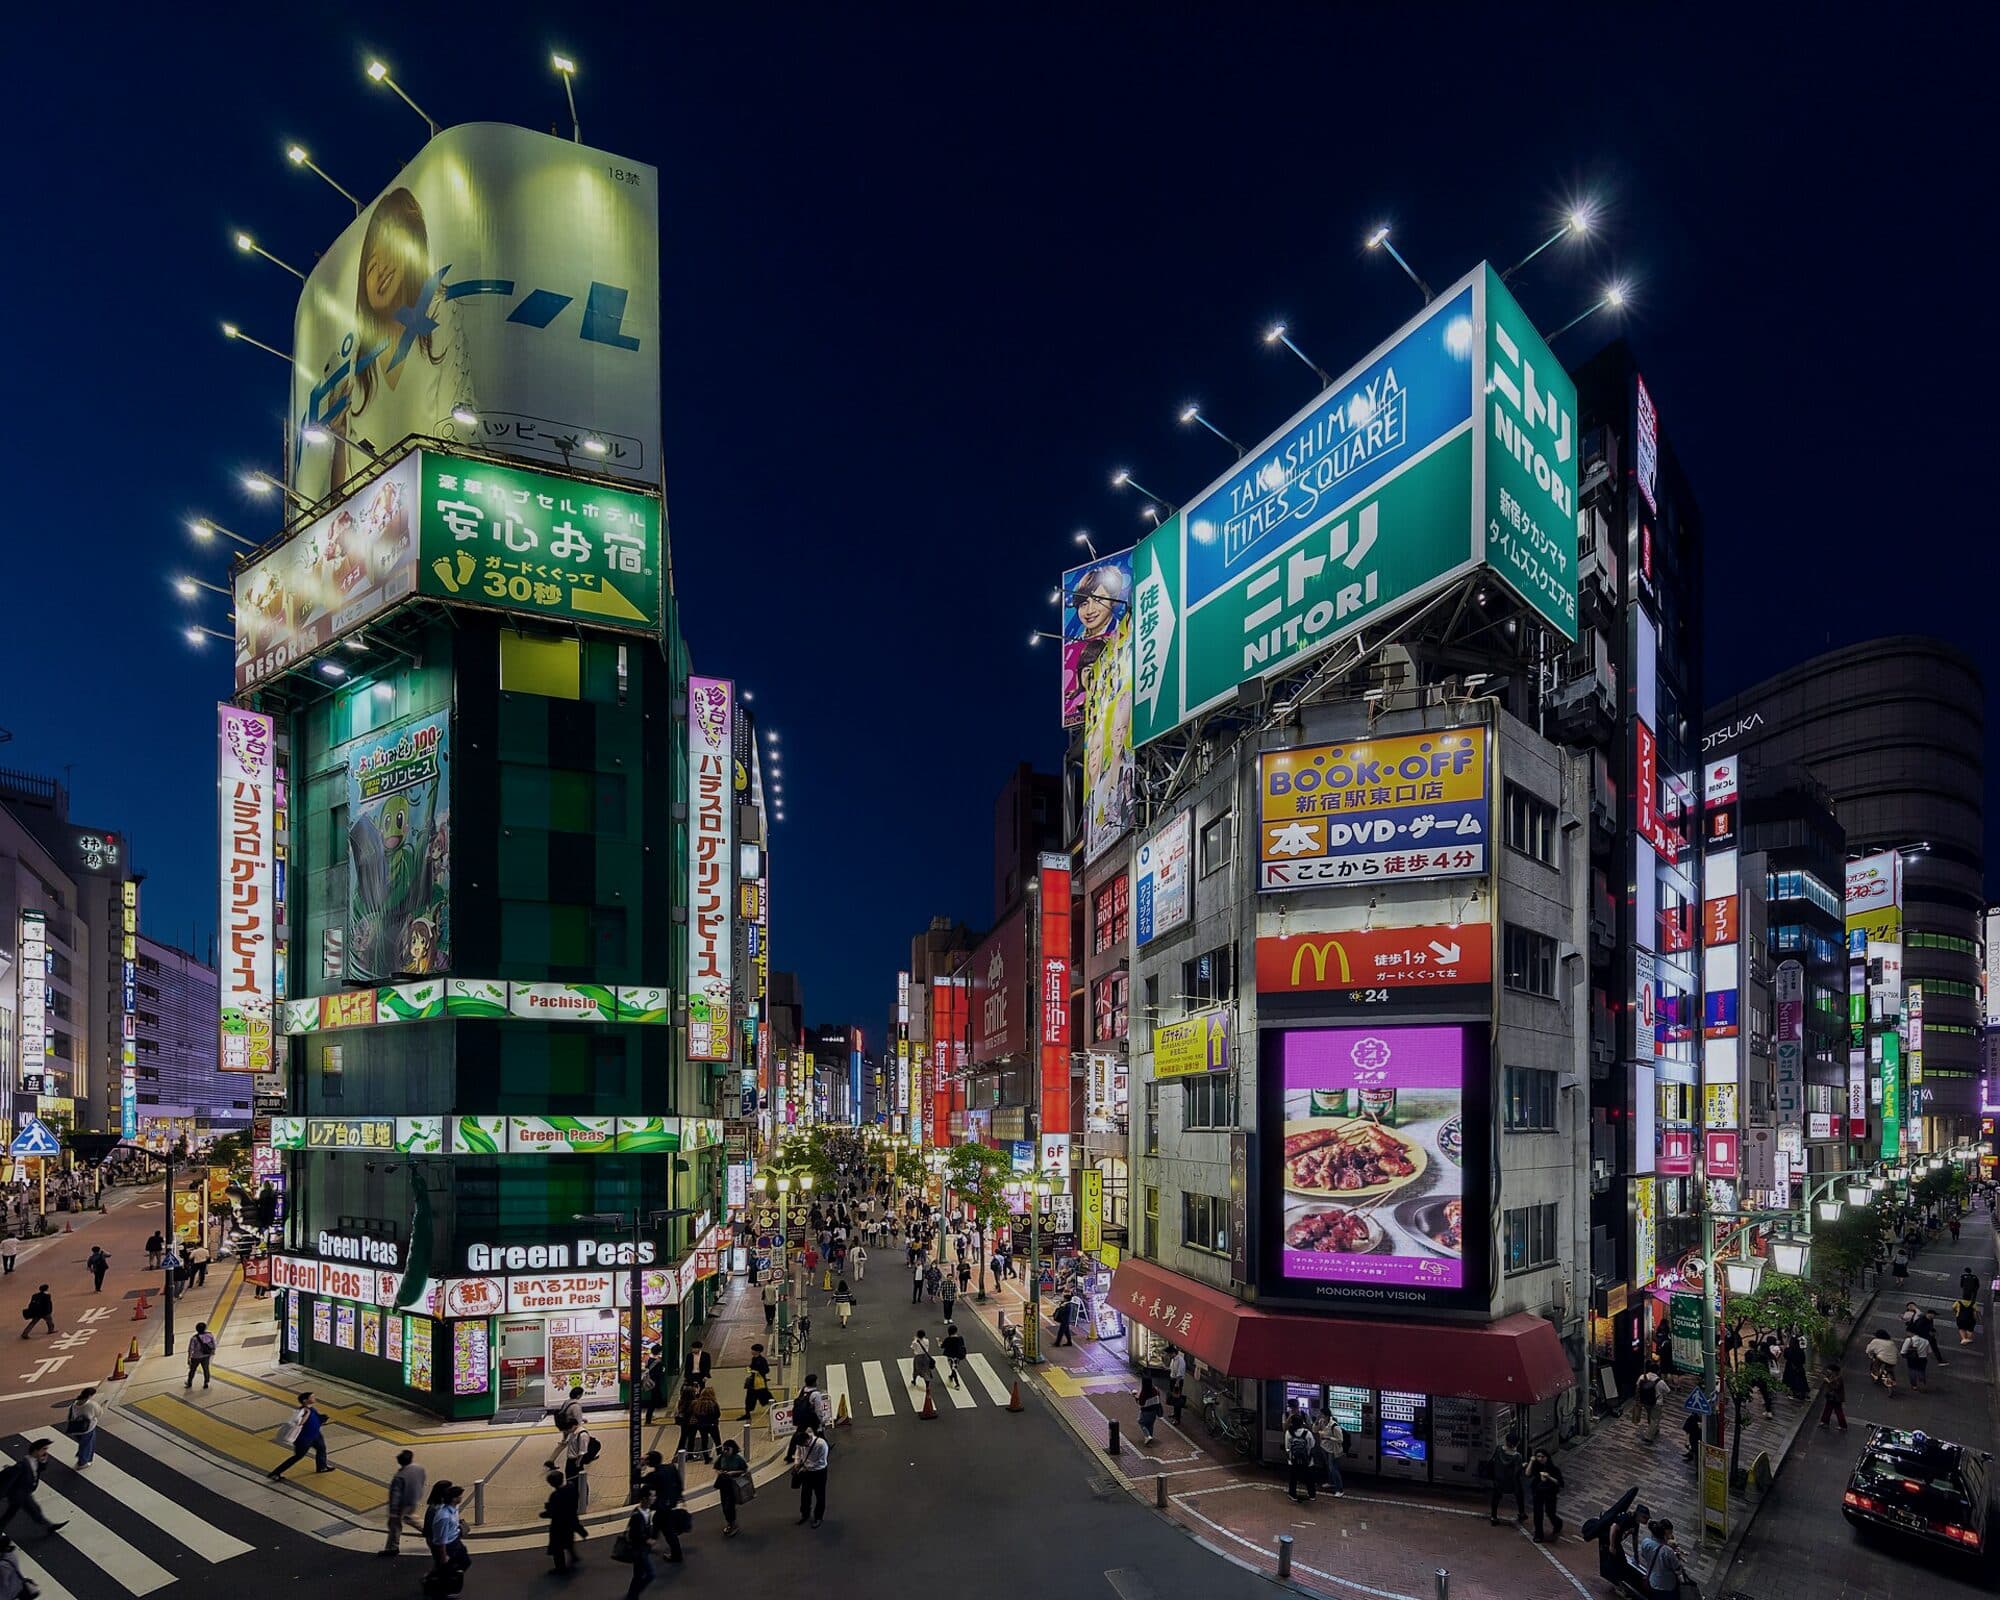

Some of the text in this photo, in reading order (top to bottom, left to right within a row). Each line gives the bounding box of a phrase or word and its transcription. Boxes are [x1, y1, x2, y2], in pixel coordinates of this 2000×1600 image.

[608, 167, 641, 187] 18禁
[1494, 321, 1572, 463] ニトリ
[1494, 401, 1572, 520] NITORI
[1230, 407, 1399, 553] TIMES SQUARE
[1499, 487, 1569, 573] 新宿タカシマヤ
[484, 554, 597, 587] ガードくぐって
[1246, 500, 1379, 633] ニトリ
[1489, 517, 1576, 621] タイムズスクエア店
[483, 571, 563, 606] 30秒
[1243, 569, 1379, 672] NITORI
[1139, 584, 1160, 693] 徒歩2分
[380, 761, 432, 790] グリンピース
[1296, 781, 1444, 813] 新宿駅東口店
[1269, 822, 1321, 856] 本
[696, 755, 727, 977] パチスログリンピース
[231, 780, 266, 992] パチスログリンピース
[1715, 899, 1728, 943] アイフル
[1374, 949, 1428, 967] 徒歩1分
[1376, 968, 1458, 982] ガードくぐって左
[529, 993, 598, 1009] Pachislo
[1051, 973, 1066, 1042] GAME
[1365, 989, 1390, 1002] 24
[1780, 1003, 1792, 1040] Serina
[310, 1122, 392, 1147] レア台の聖地
[519, 1129, 605, 1141] Green Peas
[1047, 1145, 1064, 1158] 6F
[318, 1230, 399, 1266] Green Peas
[467, 1239, 655, 1271] Green Peas
[274, 1257, 316, 1290] Green
[322, 1263, 360, 1298] Peas
[460, 1283, 489, 1303] 新
[513, 1277, 610, 1294] 選べるスロット
[1316, 1286, 1426, 1301] MONOKROM VISION
[523, 1293, 601, 1307] Green Peas
[1149, 1298, 1194, 1336] 長野屋
